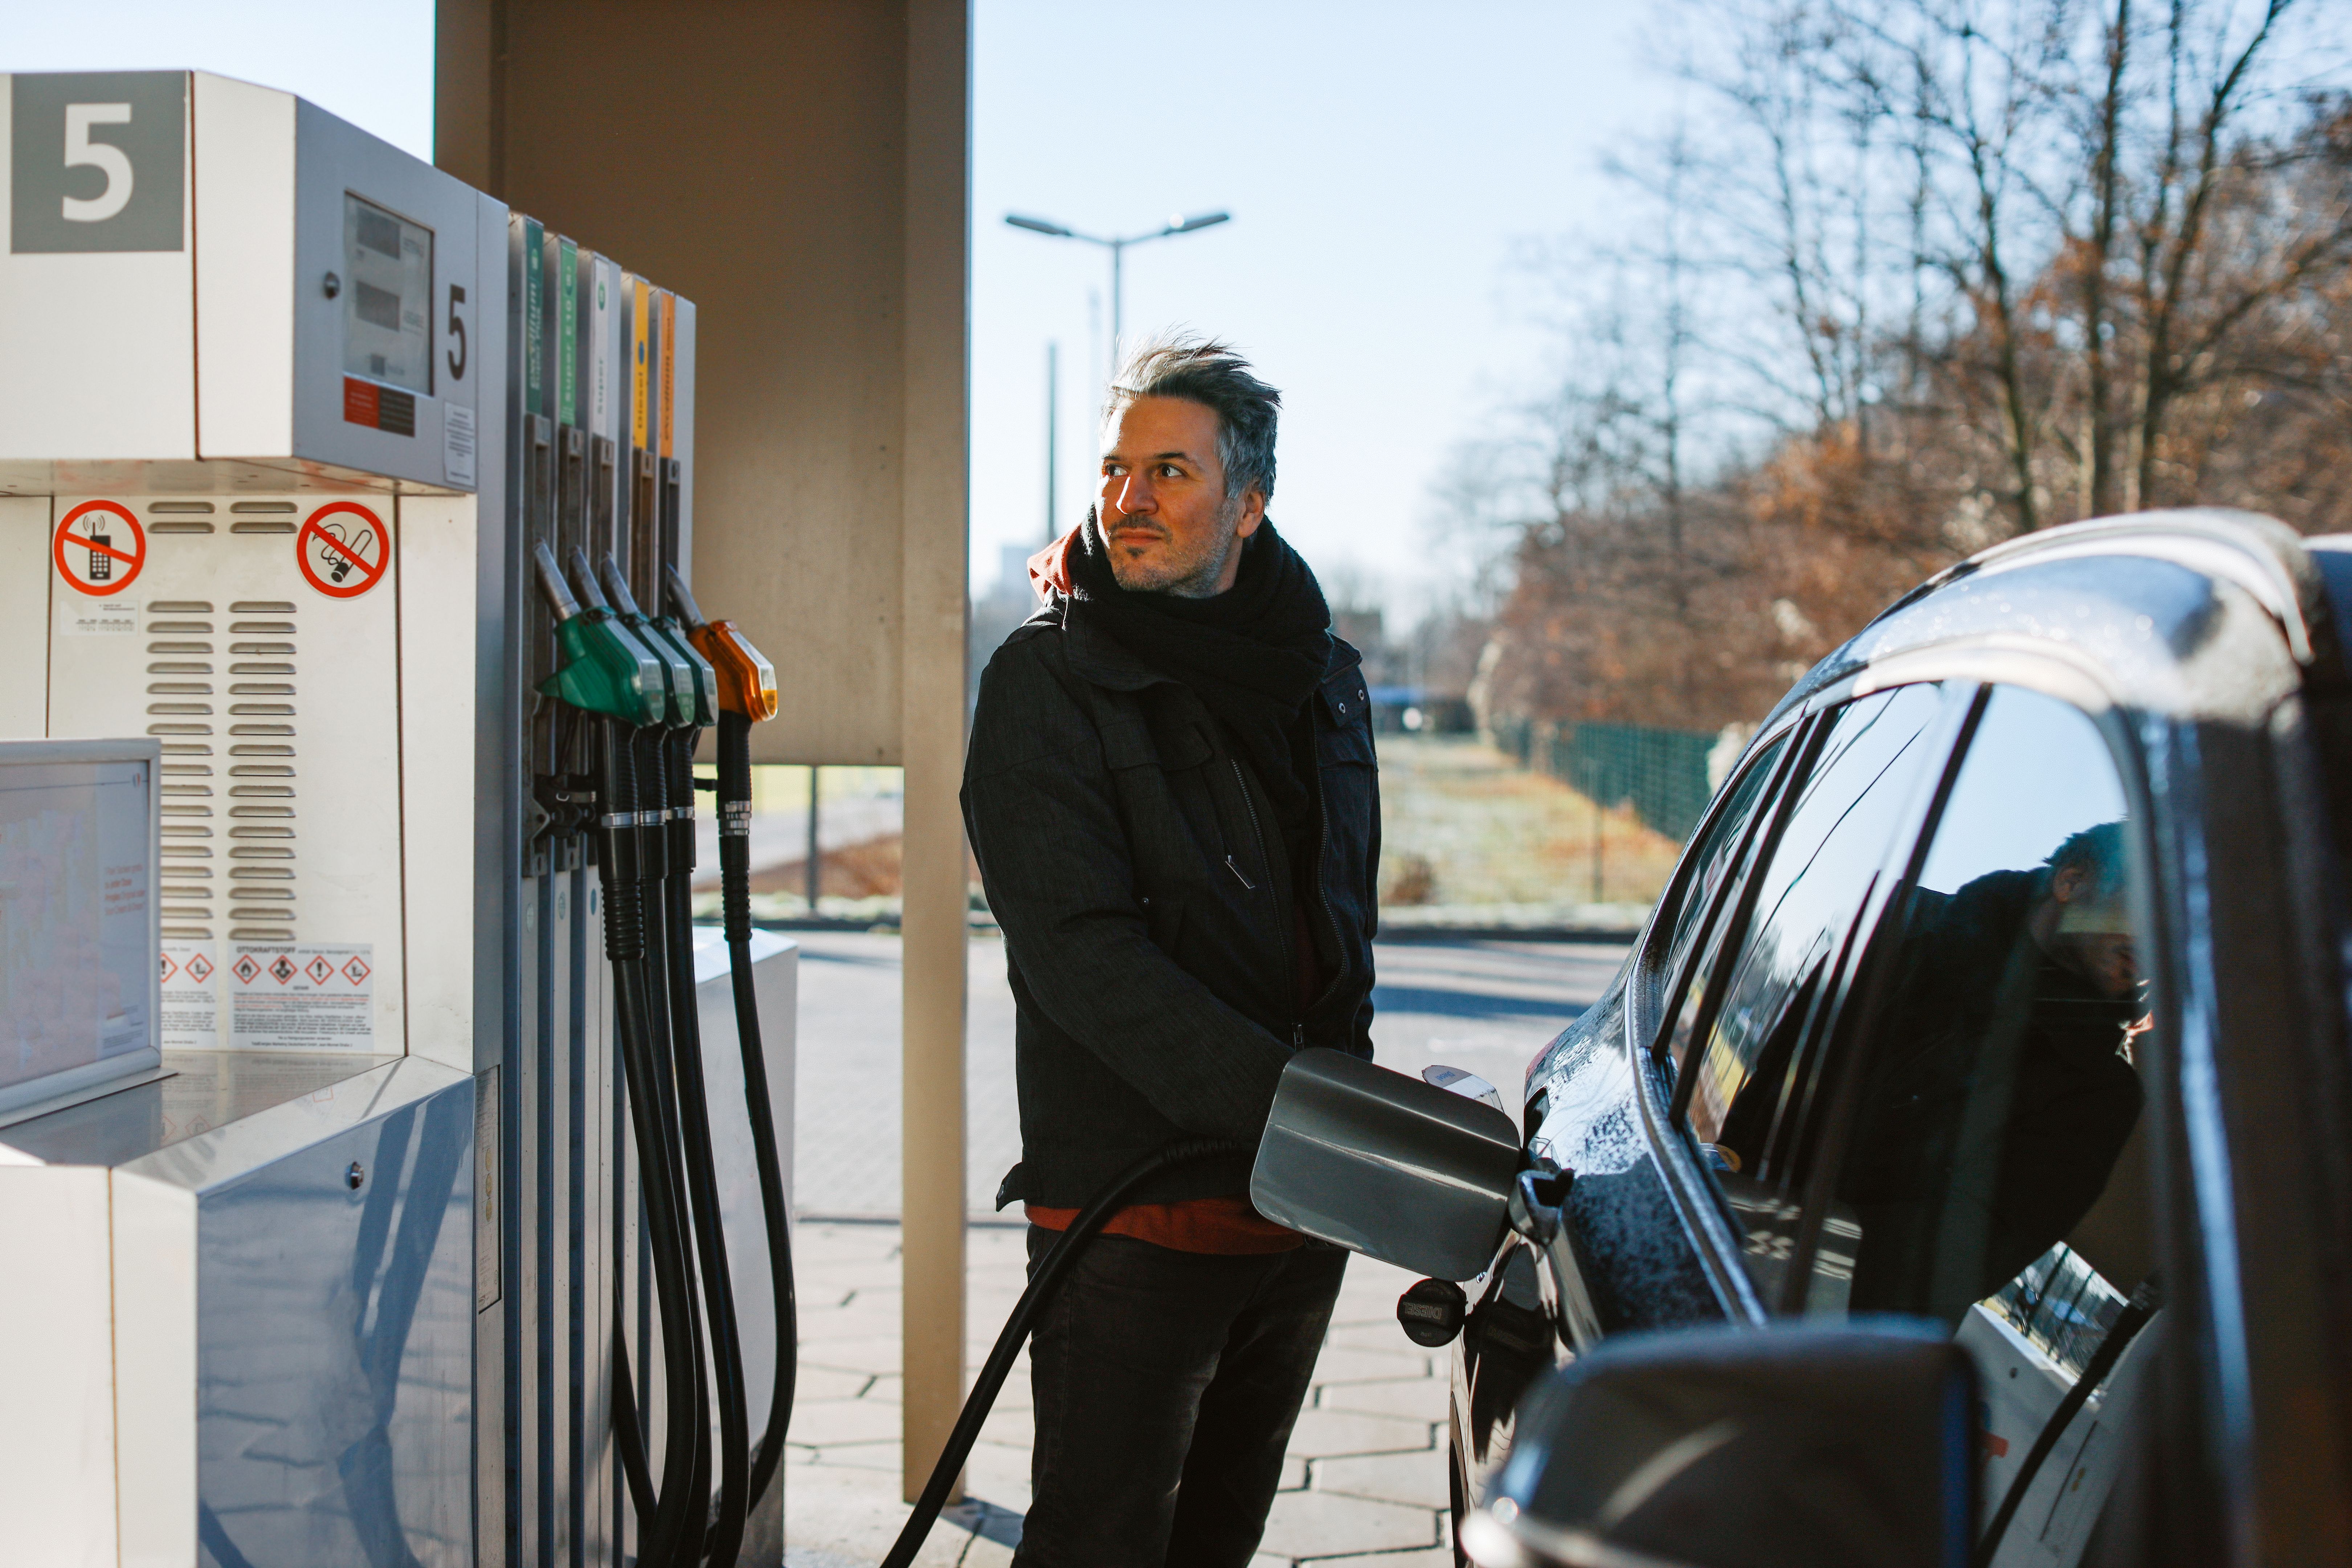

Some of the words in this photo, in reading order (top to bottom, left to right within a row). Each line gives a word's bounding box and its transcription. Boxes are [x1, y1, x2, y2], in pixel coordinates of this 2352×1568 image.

[62, 103, 134, 222] 5
[448, 284, 466, 380] 5
[1403, 1302, 1442, 1319] DIESEL
